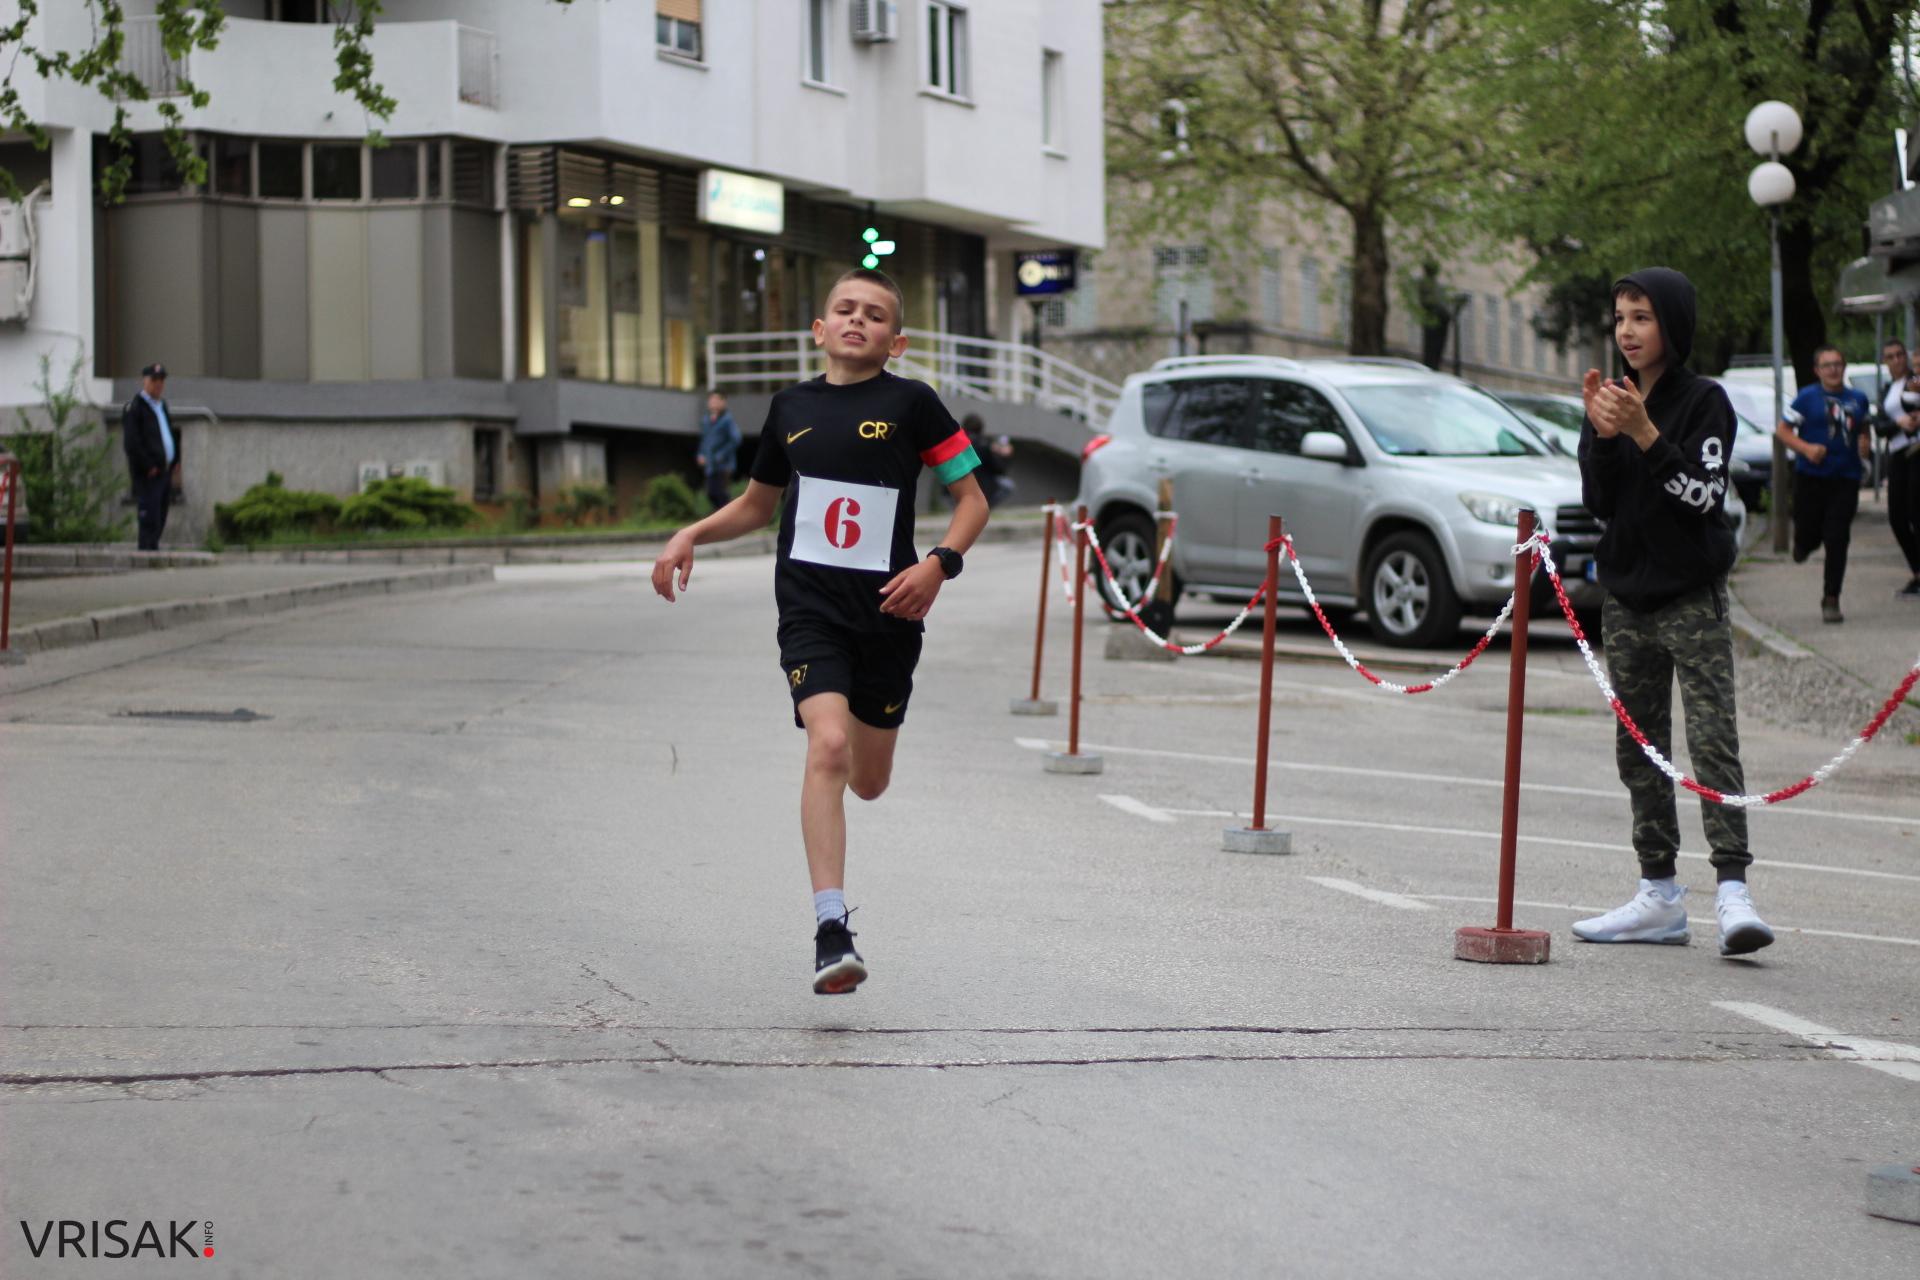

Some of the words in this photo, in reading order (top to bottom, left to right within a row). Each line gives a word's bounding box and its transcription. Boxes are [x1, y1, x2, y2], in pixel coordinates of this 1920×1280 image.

[859, 421, 897, 439] CR7
[824, 497, 861, 549] 6
[789, 664, 808, 687] R7
